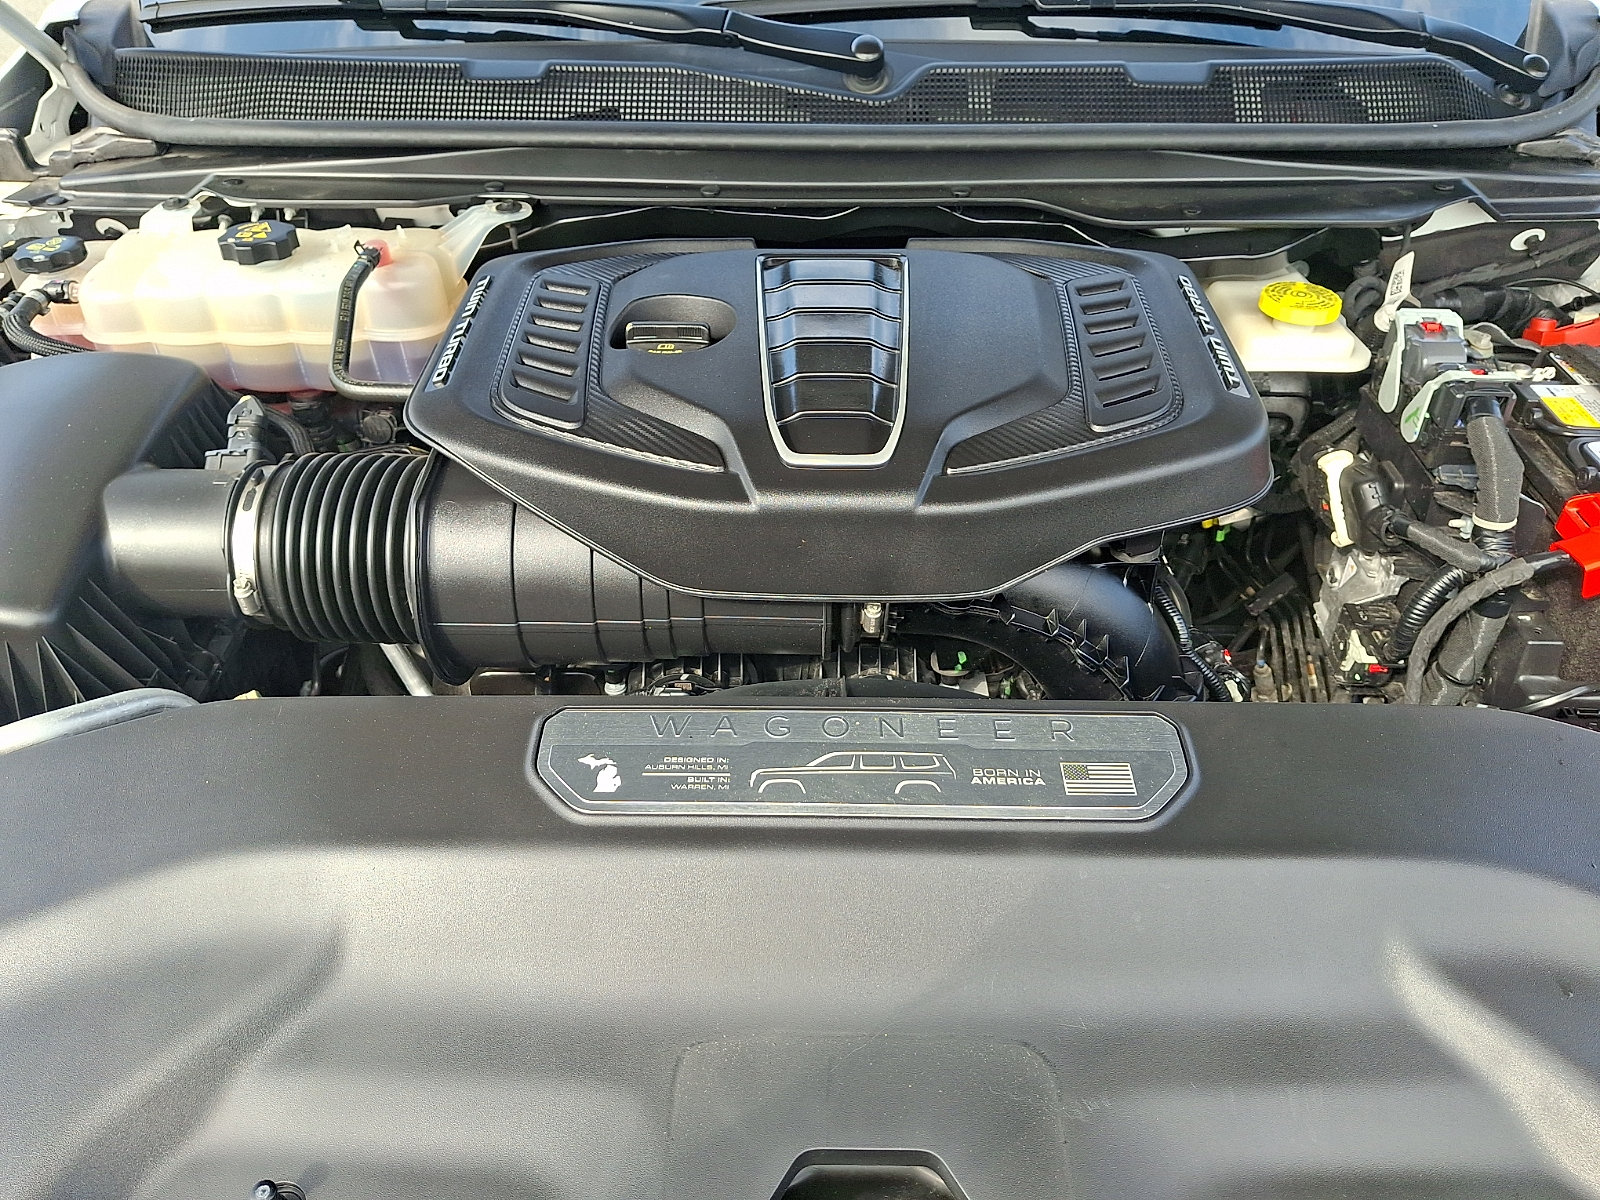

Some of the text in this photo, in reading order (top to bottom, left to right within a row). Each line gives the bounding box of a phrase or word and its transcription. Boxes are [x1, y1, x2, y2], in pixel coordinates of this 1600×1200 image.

[432, 275, 491, 385] TWIN TURBO
[1178, 274, 1240, 387] TWIN TURBO
[649, 713, 1076, 742] WAGONEER
[970, 776, 1046, 786] AMERICA
[972, 768, 1041, 778] BORN IN
